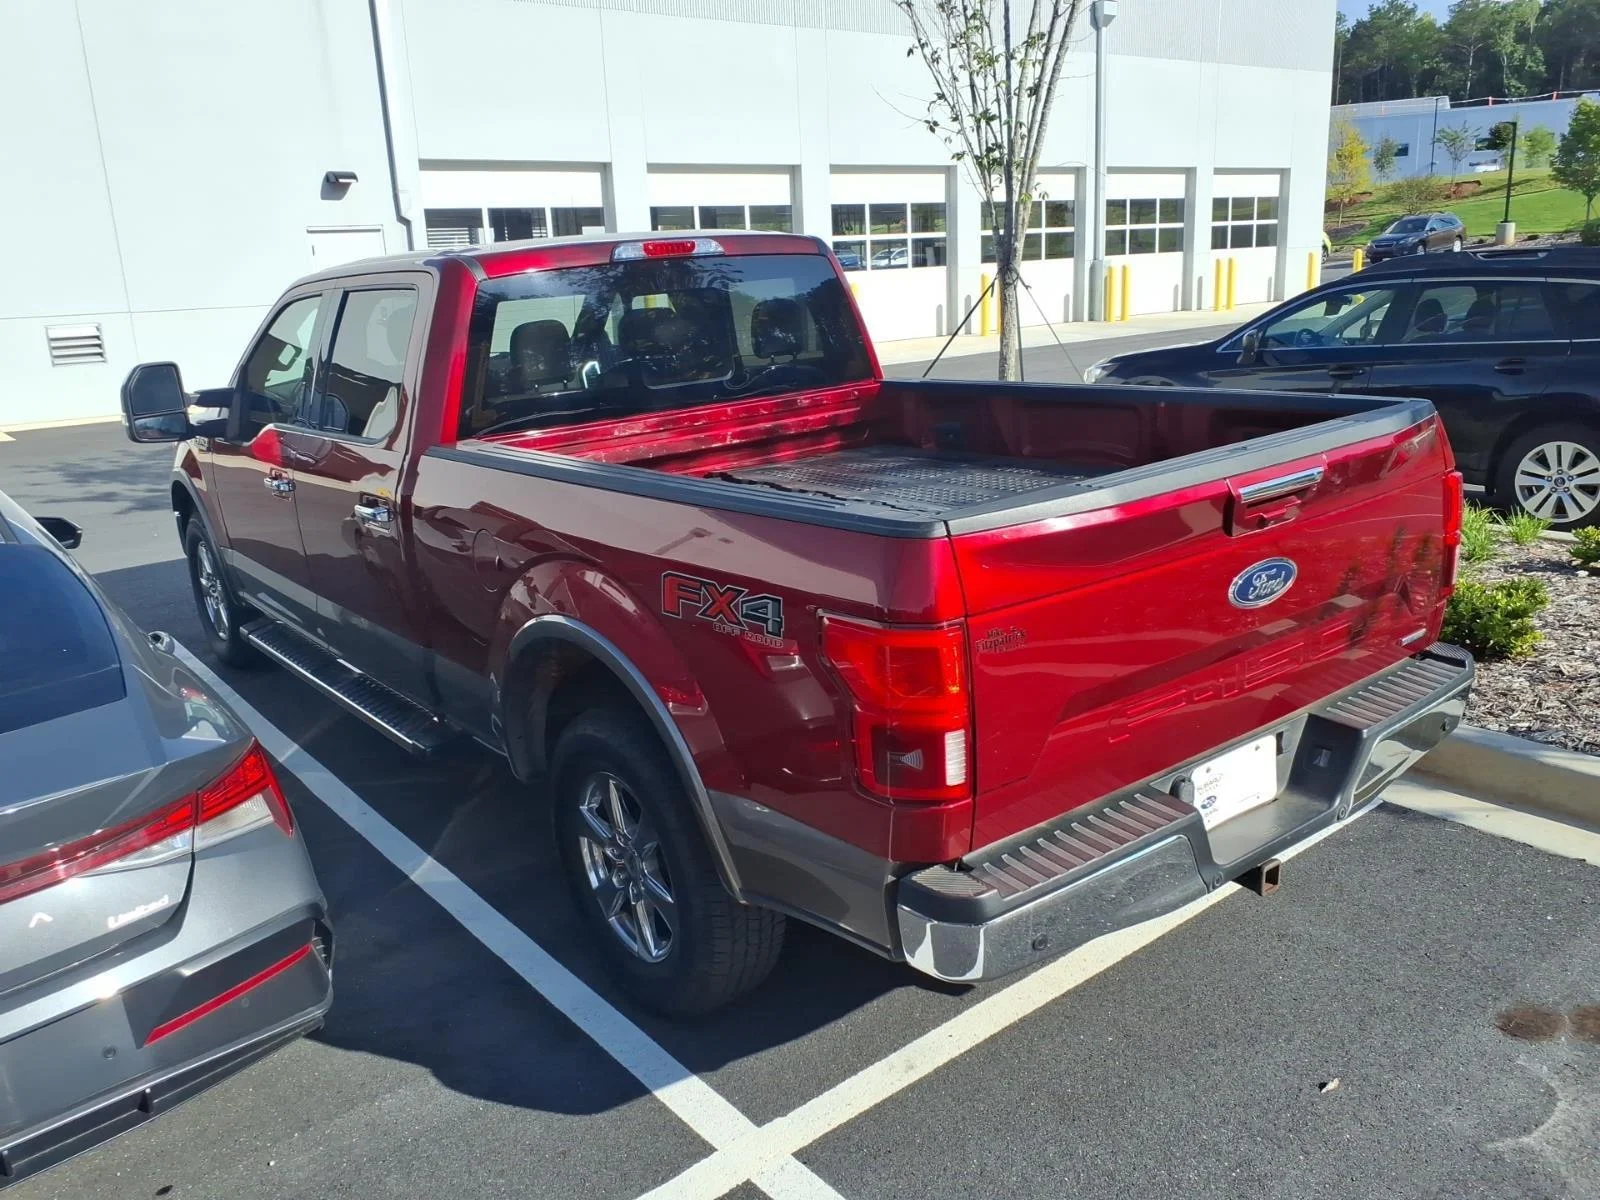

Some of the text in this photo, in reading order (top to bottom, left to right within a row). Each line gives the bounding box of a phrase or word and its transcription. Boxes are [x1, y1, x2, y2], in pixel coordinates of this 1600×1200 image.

[1248, 568, 1286, 599] Ford
[661, 570, 785, 640] FX4
[712, 622, 784, 648] OFF ROAD
